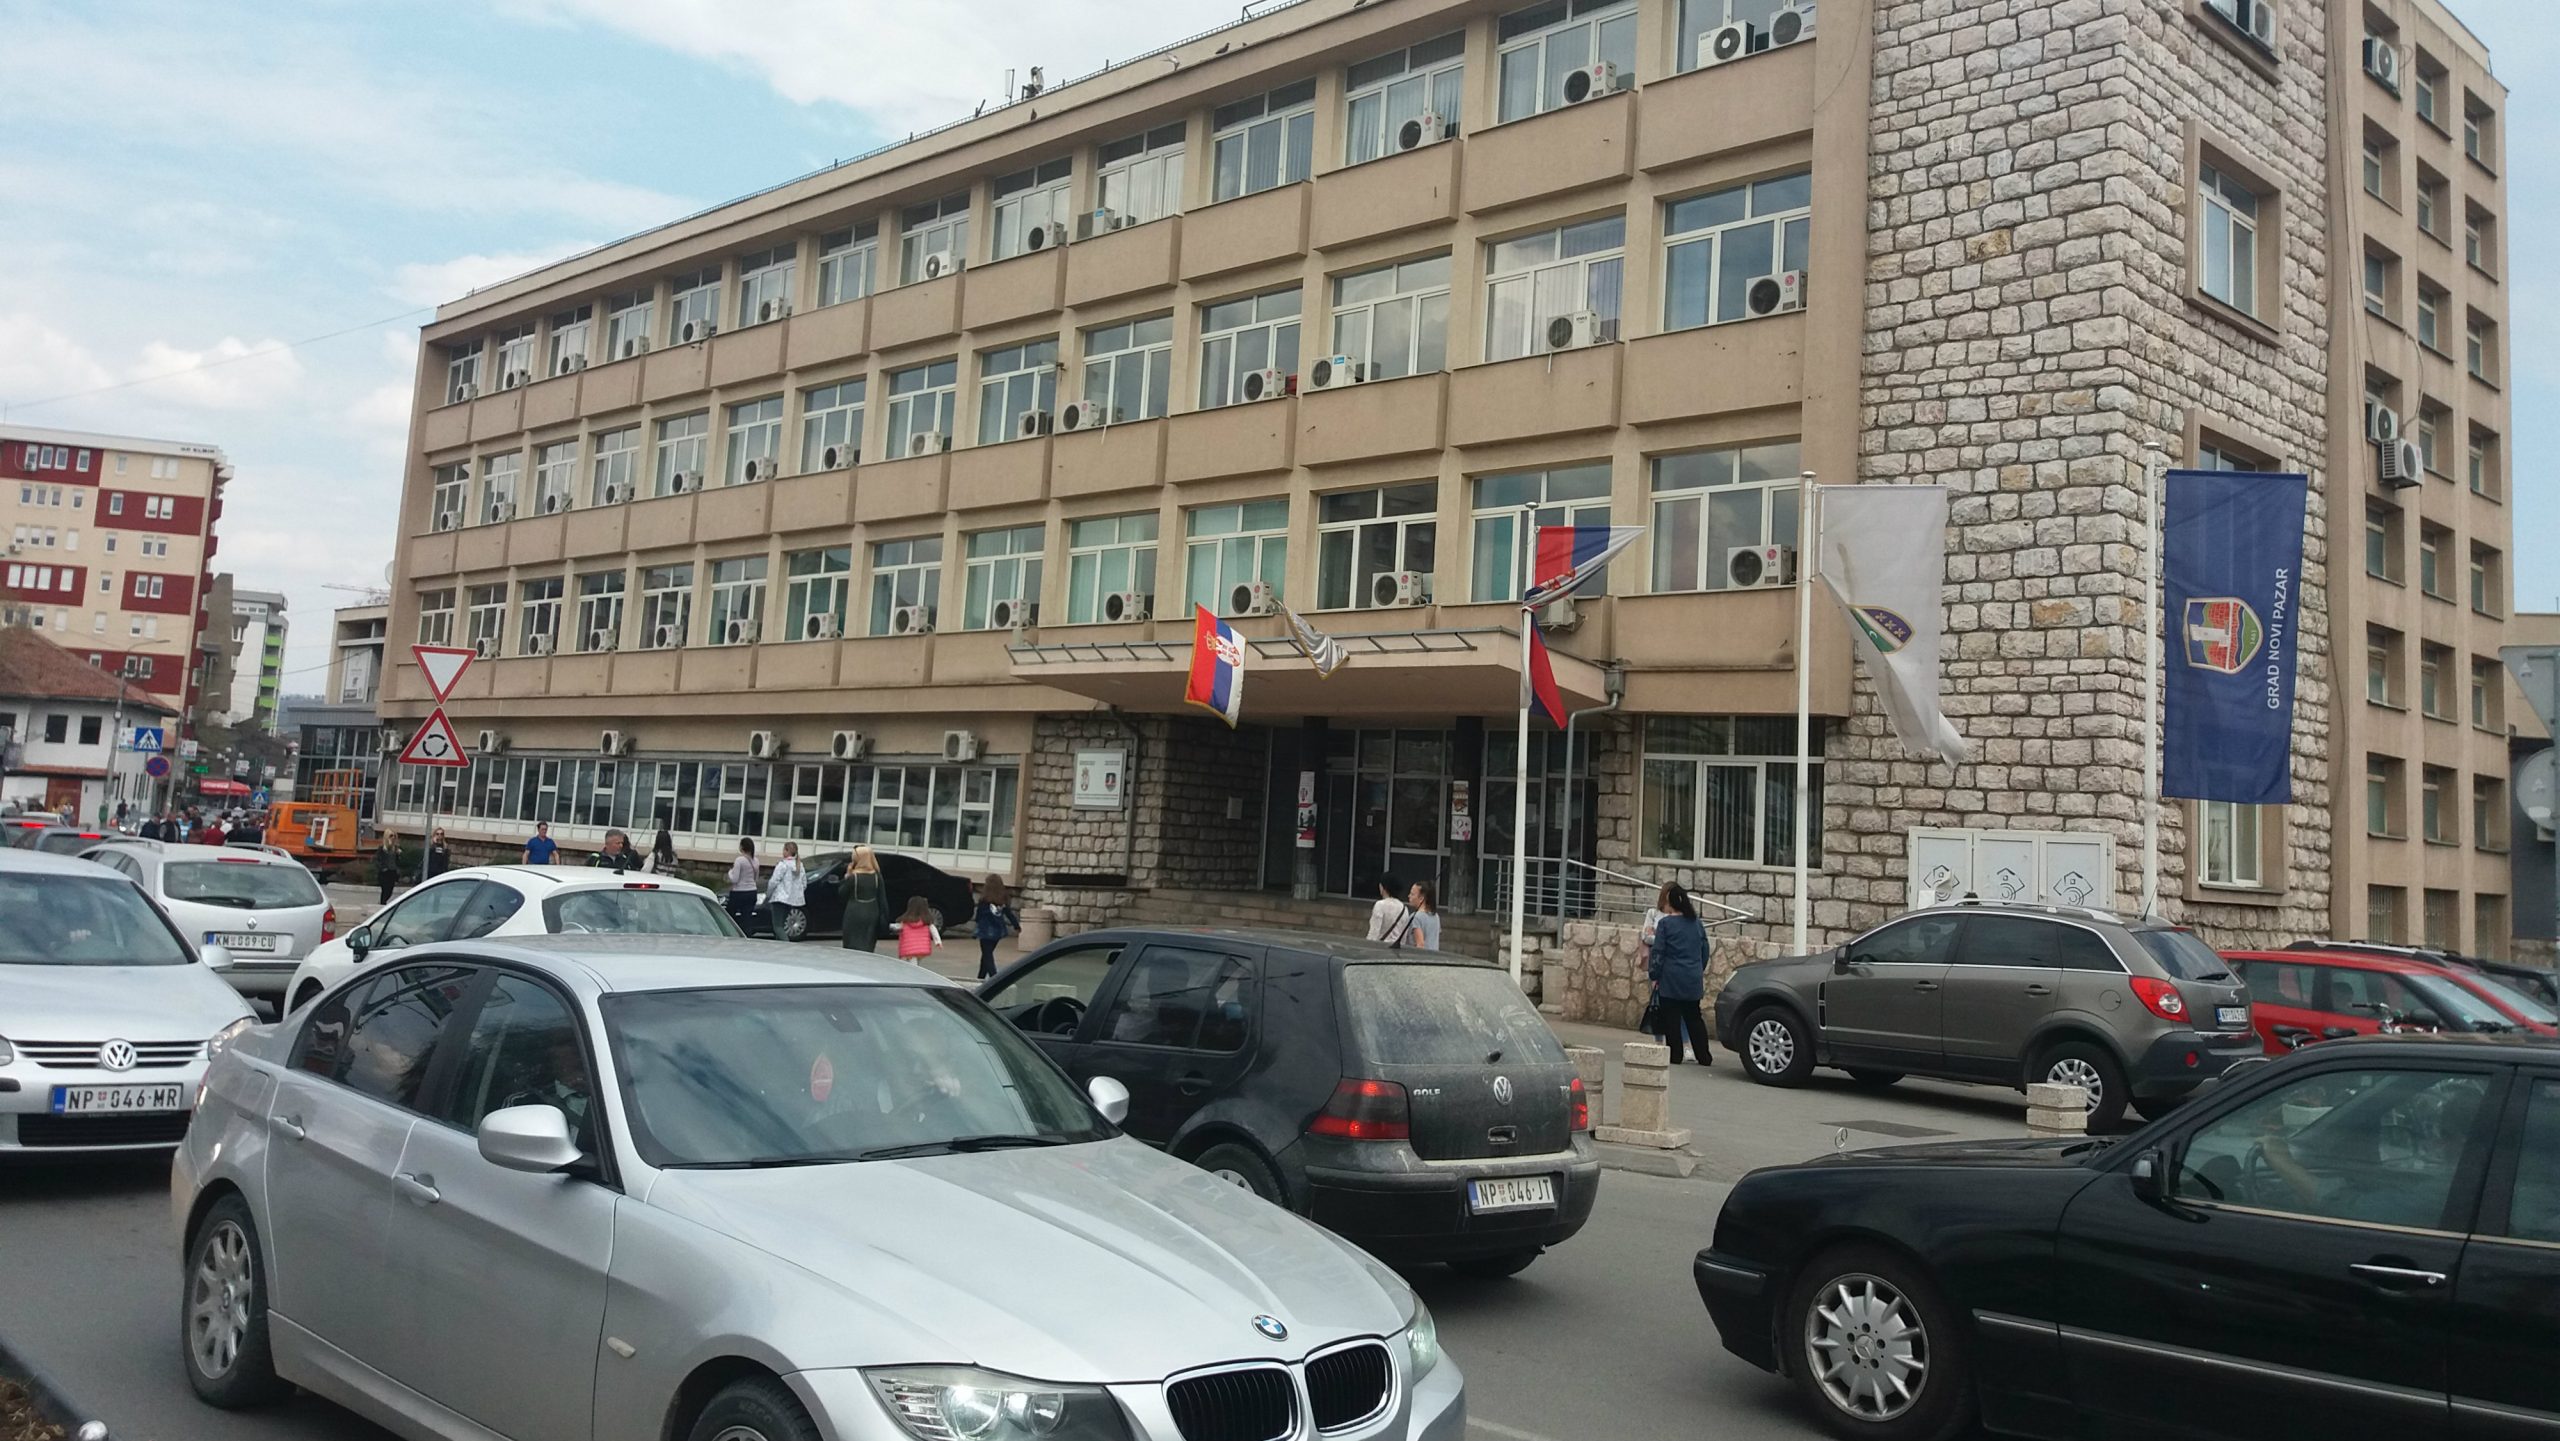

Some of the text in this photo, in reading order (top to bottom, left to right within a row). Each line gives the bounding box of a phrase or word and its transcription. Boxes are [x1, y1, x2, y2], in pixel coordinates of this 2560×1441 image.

[2267, 567, 2289, 709] GRAD NOVI PAZAR
[68, 1091, 94, 1110] NP
[1479, 1183, 1497, 1206] NP
